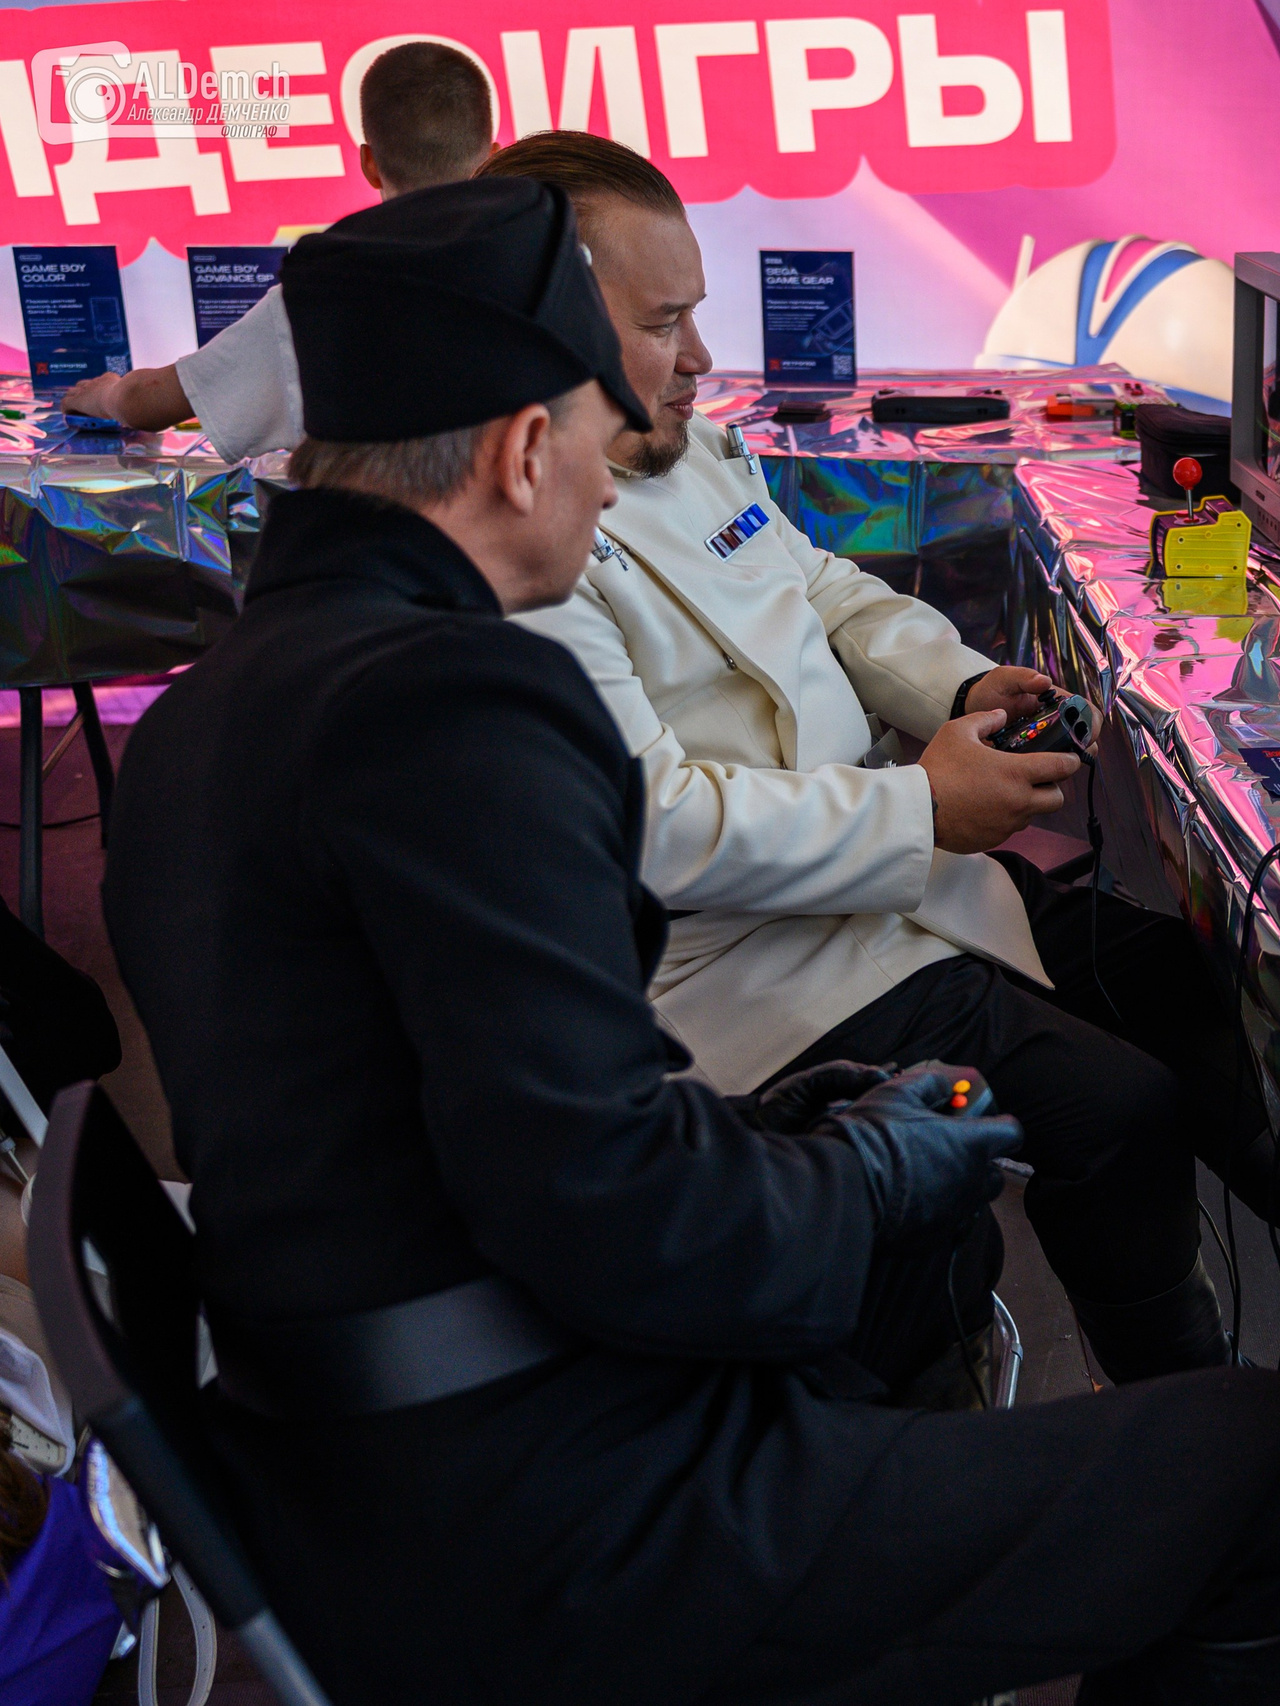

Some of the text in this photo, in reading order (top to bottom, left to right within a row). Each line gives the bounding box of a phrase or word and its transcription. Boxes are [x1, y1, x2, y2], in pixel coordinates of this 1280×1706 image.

[21, 263, 86, 273] GAME BOY
[194, 265, 259, 273] GAME BOY
[765, 268, 798, 276] SEGA
[22, 273, 66, 282] COLOR
[195, 274, 255, 283] ADVANCE
[766, 277, 834, 285] GAME GEAR
